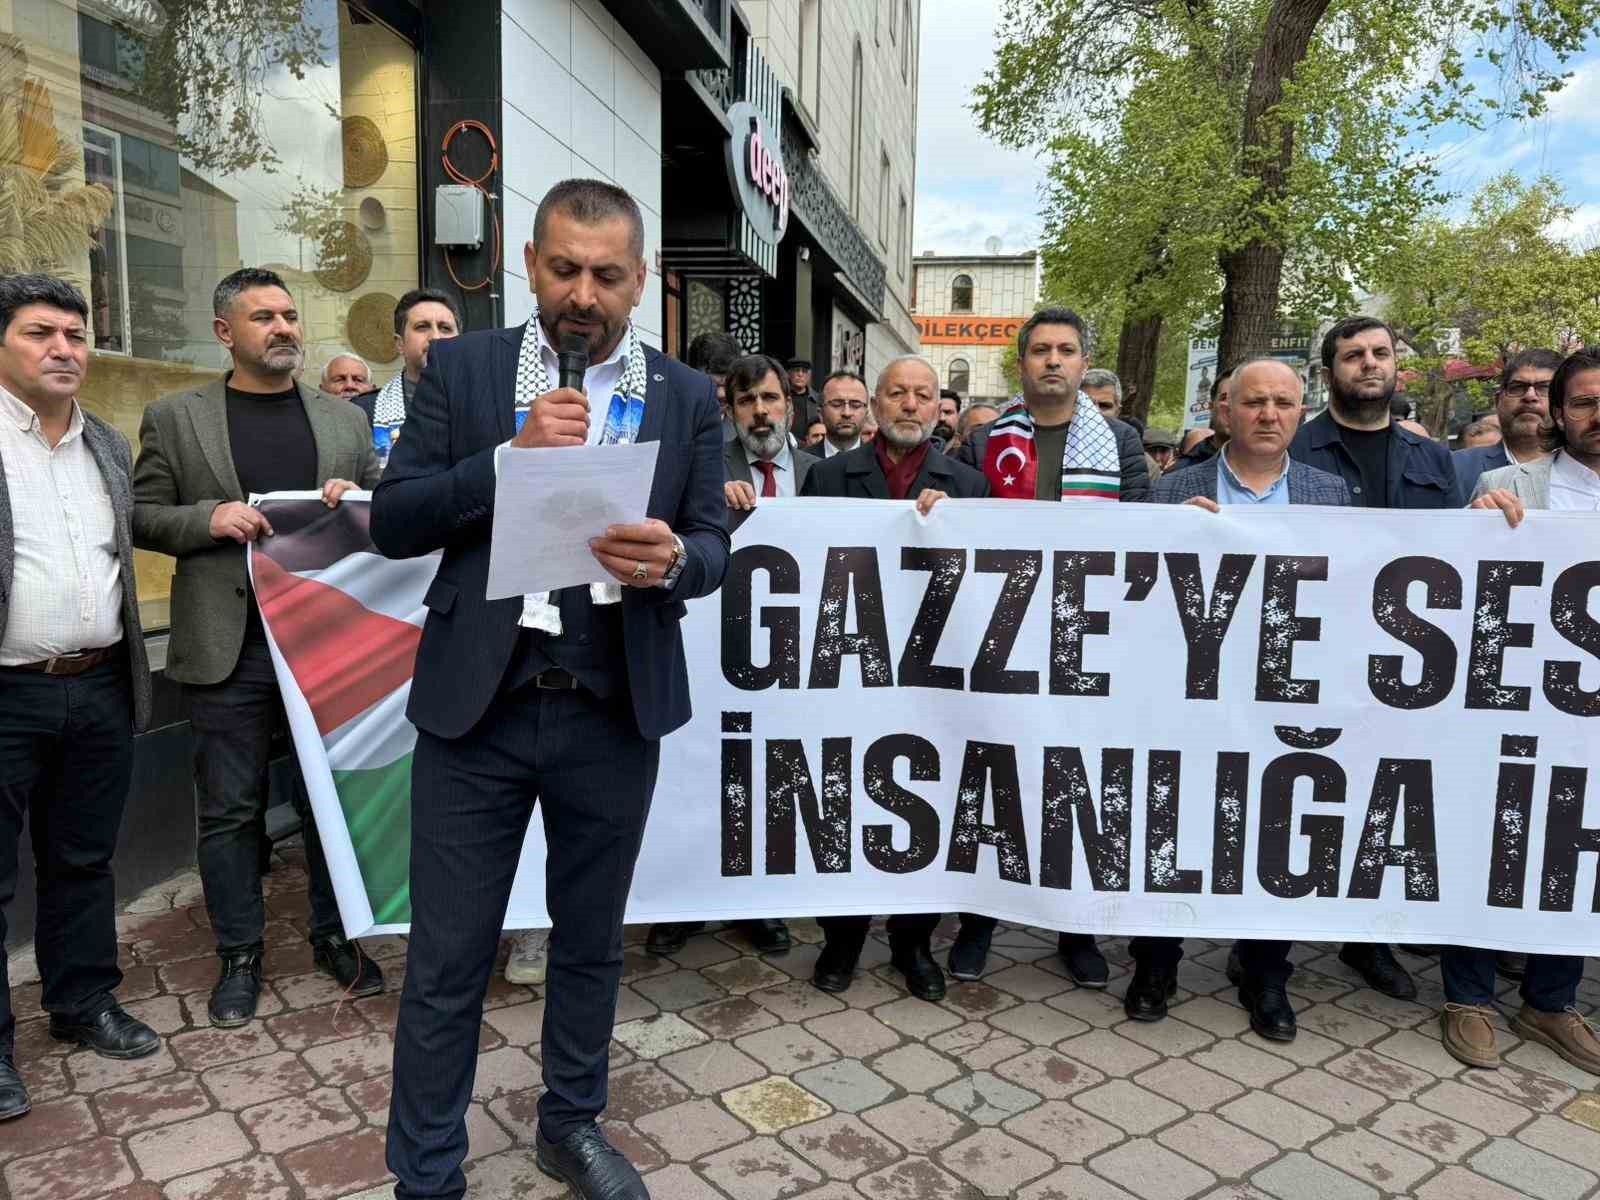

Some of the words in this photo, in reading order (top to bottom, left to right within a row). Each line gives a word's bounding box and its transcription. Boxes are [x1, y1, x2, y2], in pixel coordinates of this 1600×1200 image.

[749, 116, 788, 231] deep
[915, 319, 1024, 341] İLEKÇEC
[720, 544, 1329, 705] GAZZE'YE
[1368, 555, 1600, 717] SES
[720, 711, 1440, 902] İNSANLIĞA
[1487, 734, 1600, 914] İH
